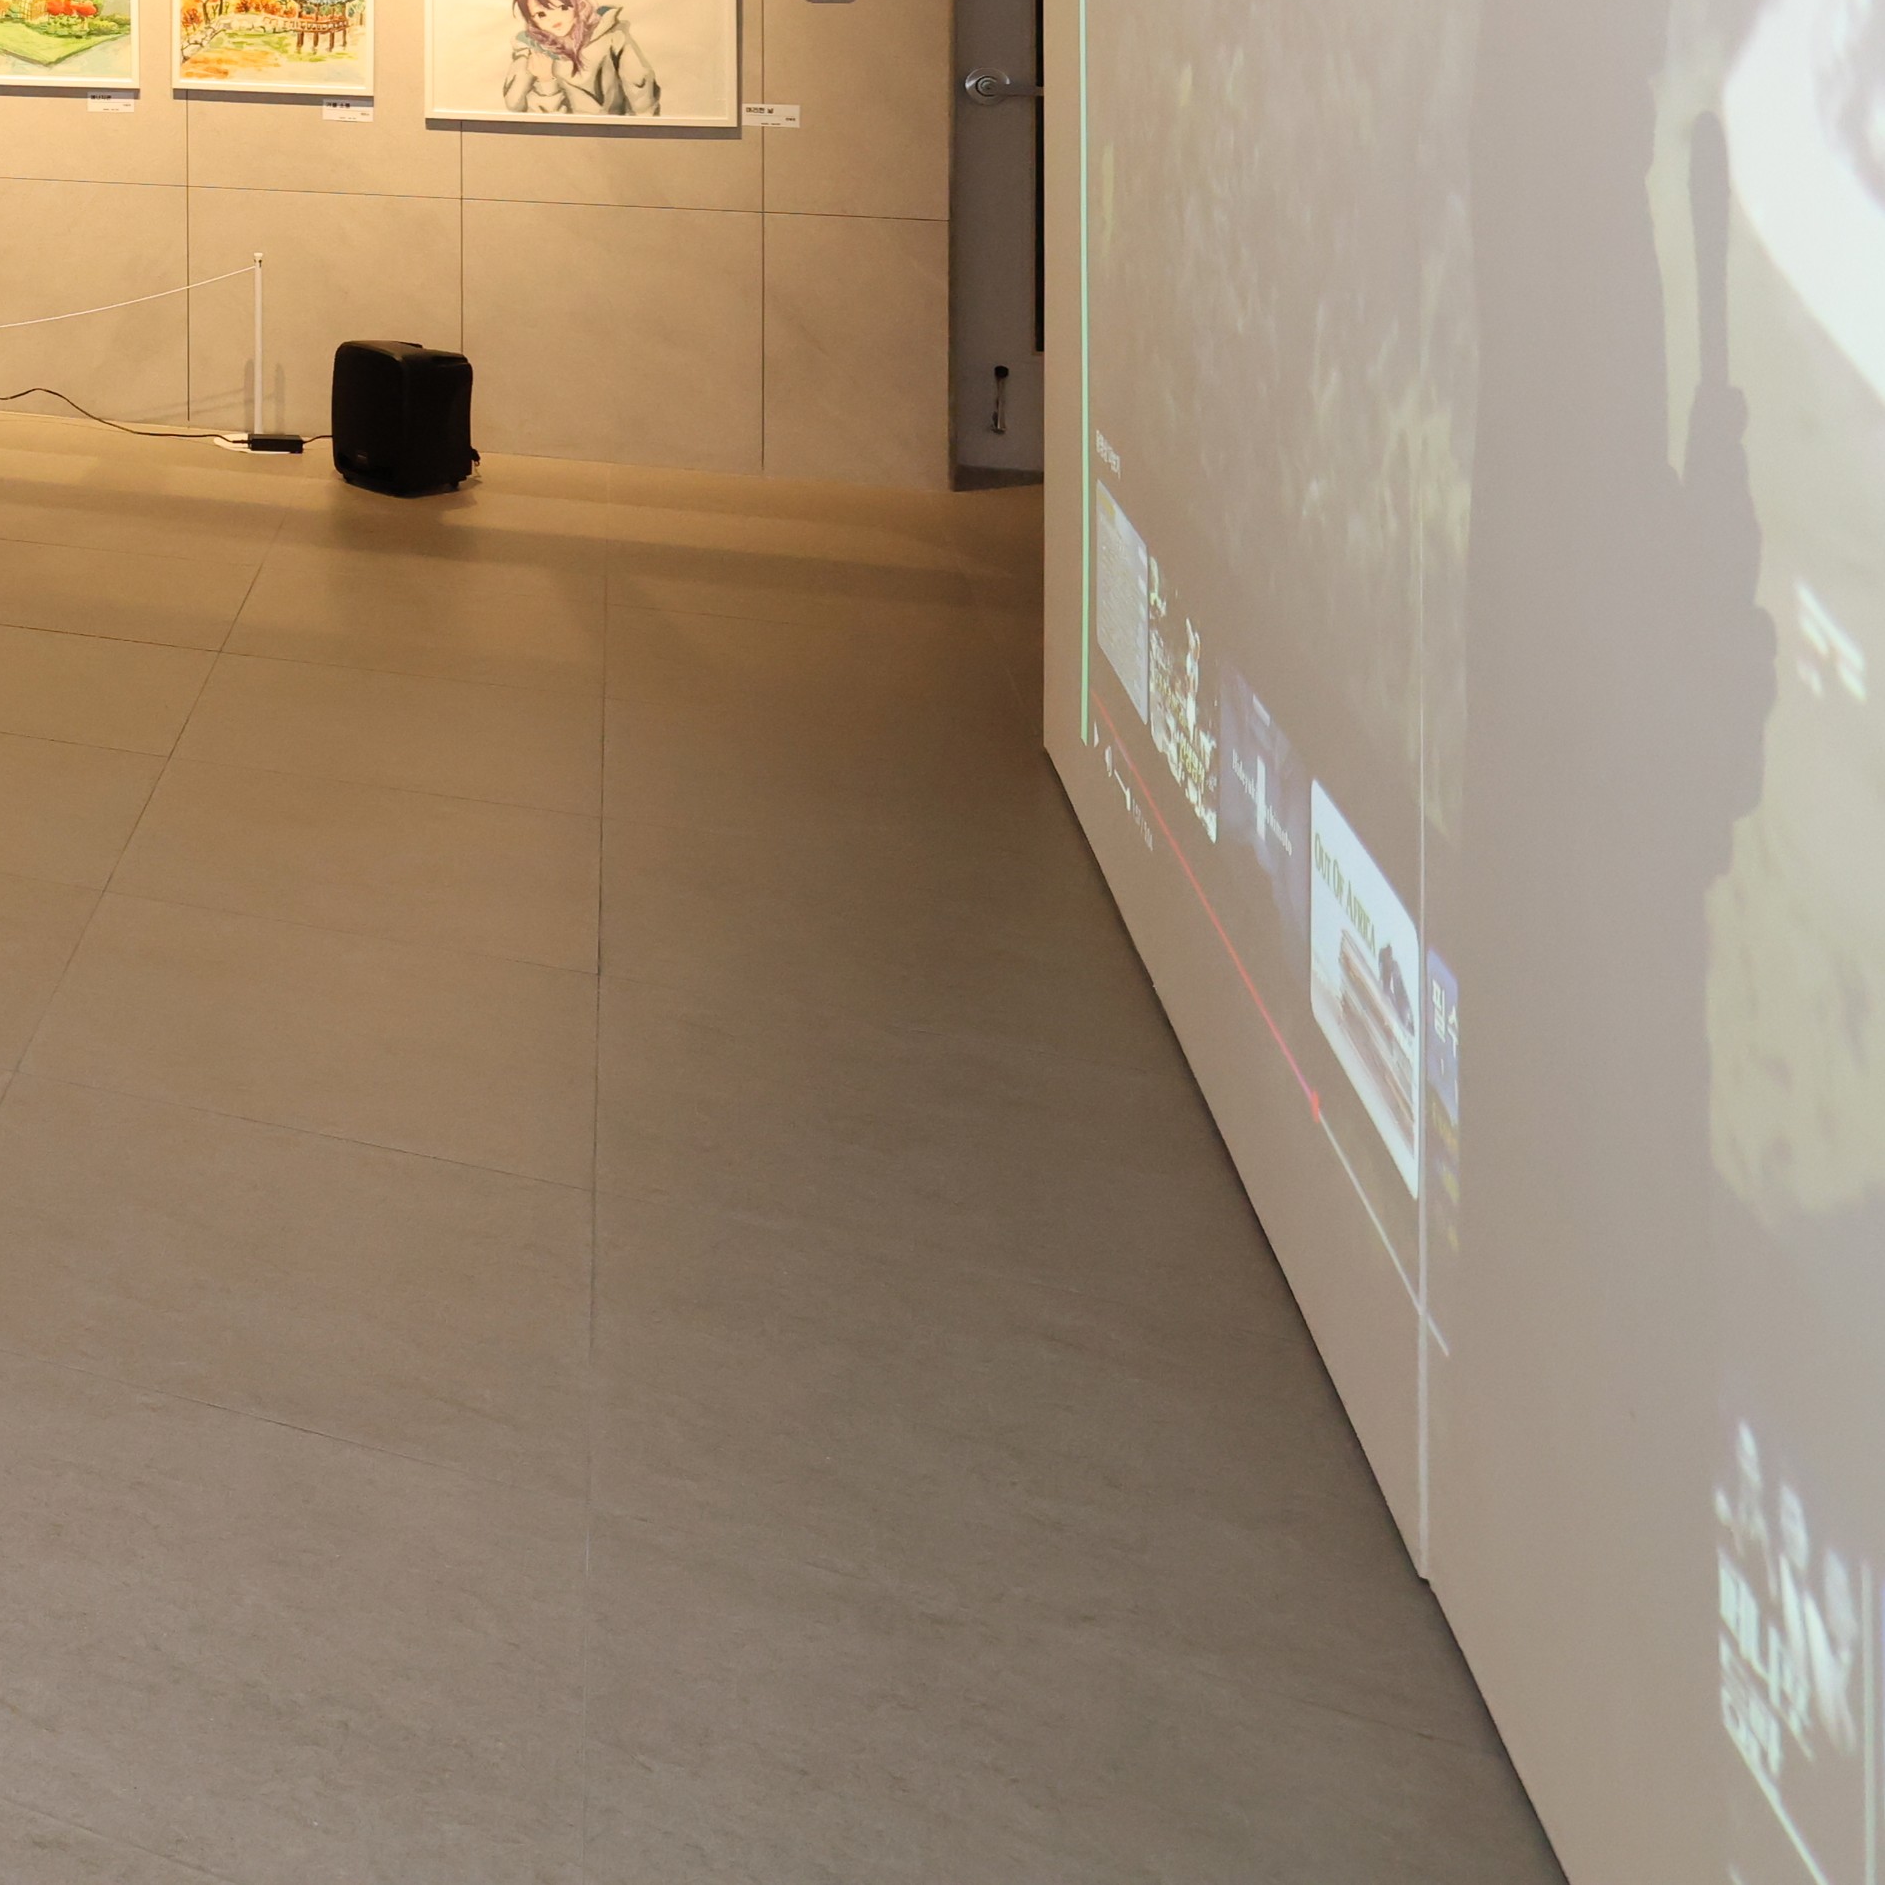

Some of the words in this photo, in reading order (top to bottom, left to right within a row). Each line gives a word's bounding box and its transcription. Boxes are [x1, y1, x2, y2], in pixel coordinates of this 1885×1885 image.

[1314, 833, 1331, 886] OUT
[1332, 859, 1345, 907] OF
[1346, 879, 1377, 958] AFRICA
